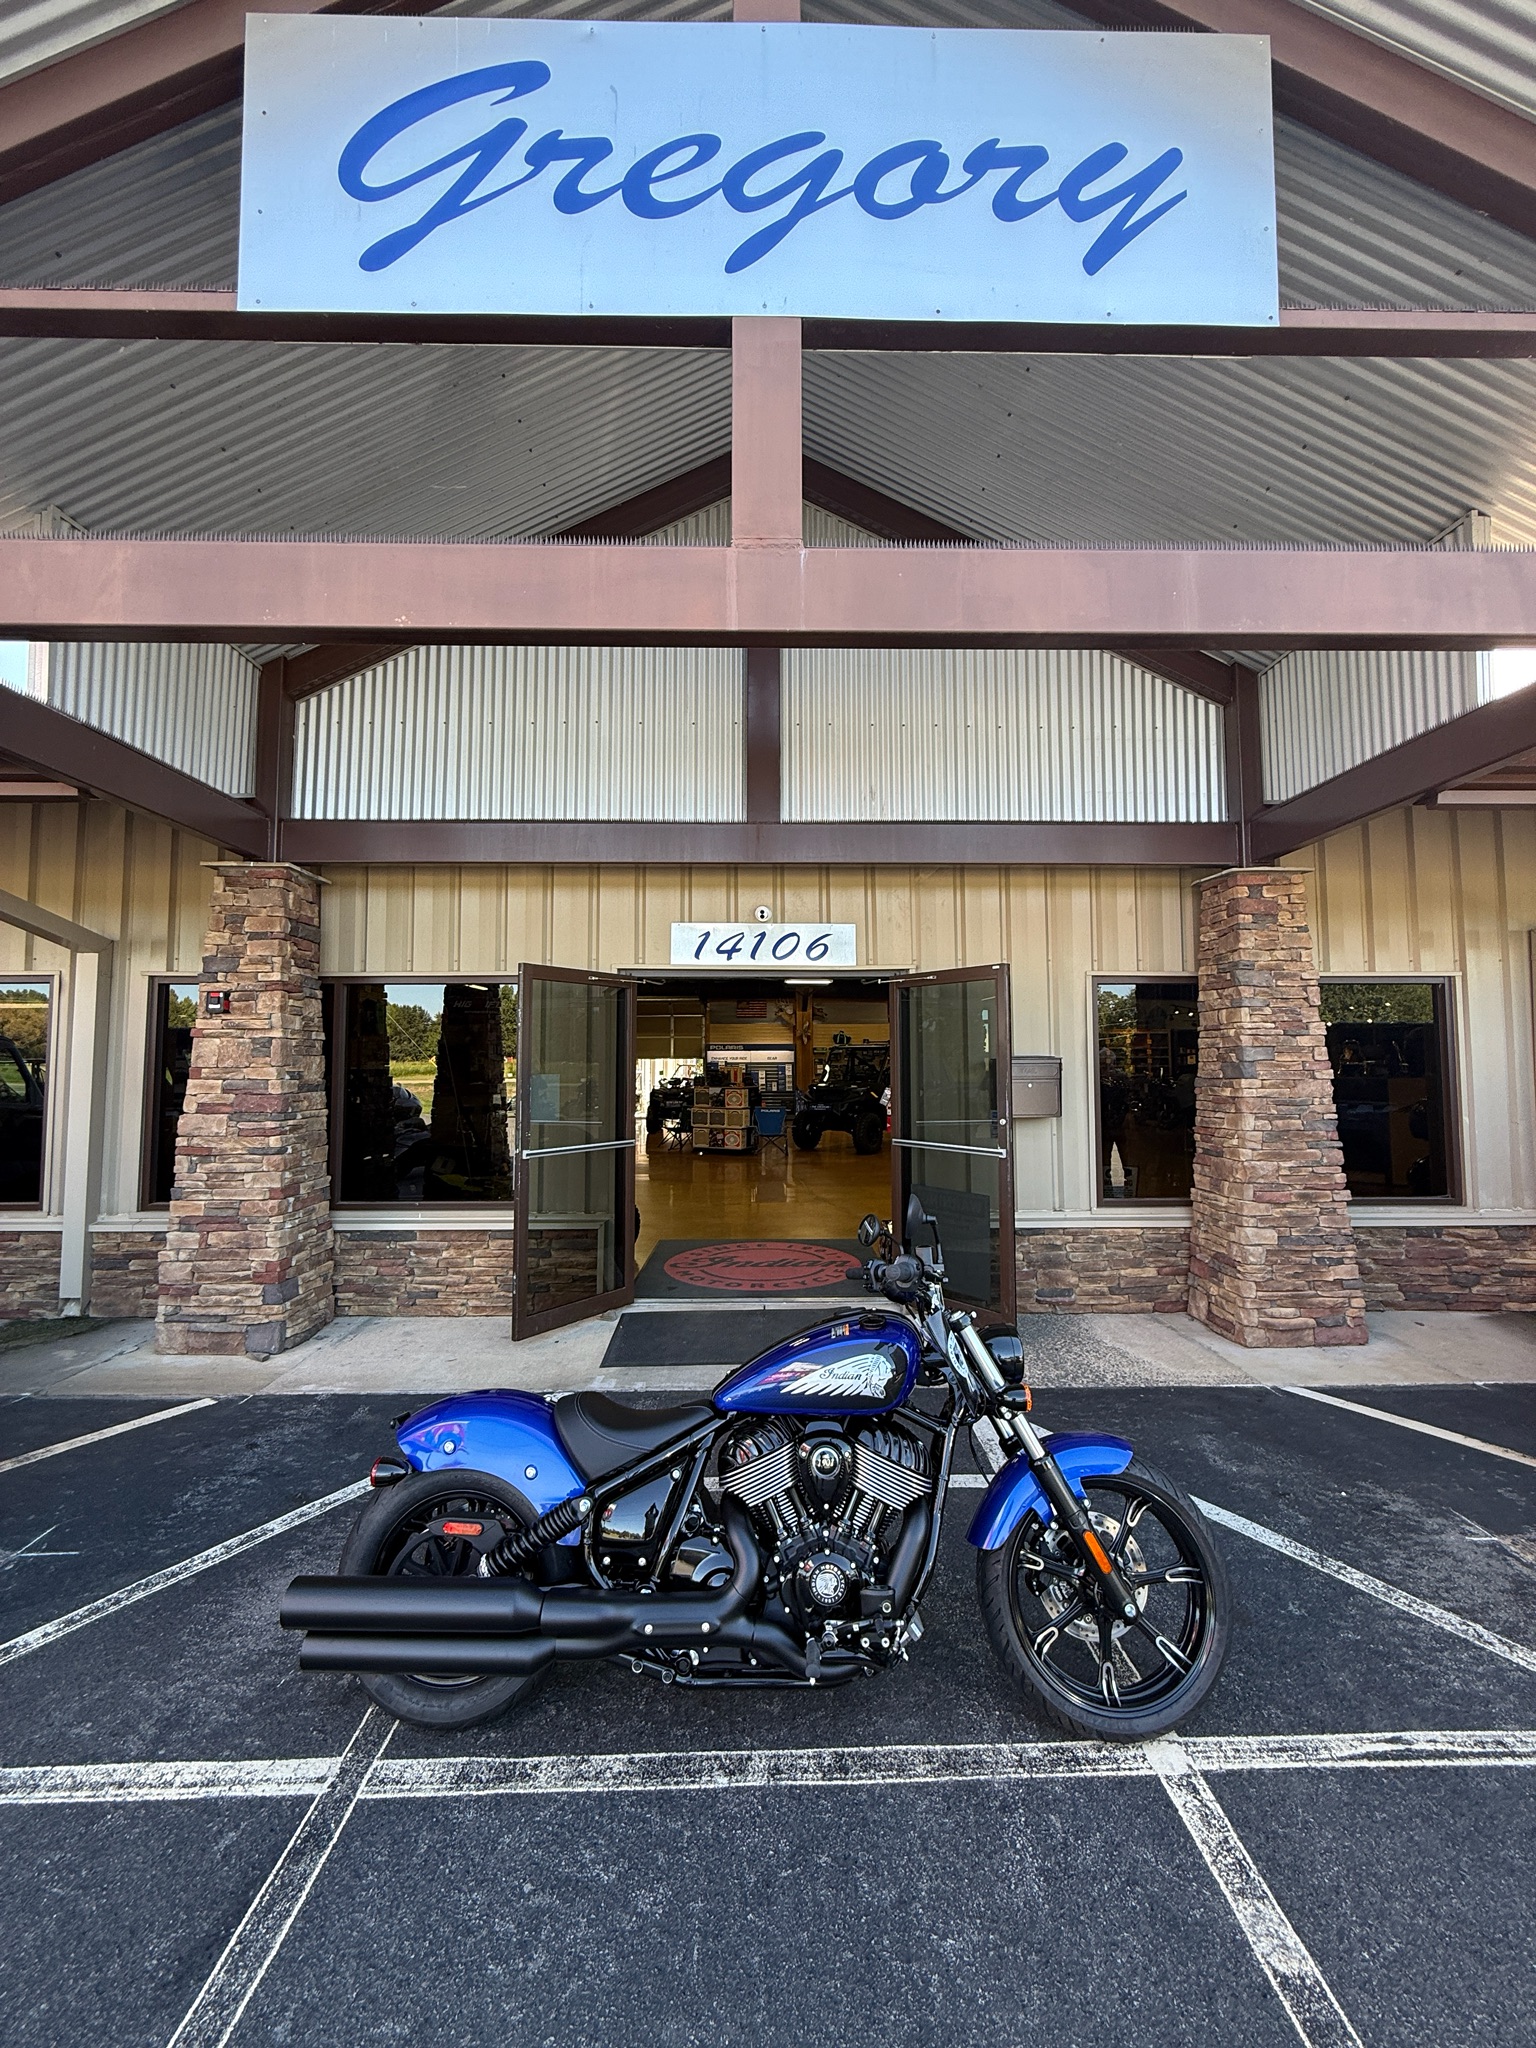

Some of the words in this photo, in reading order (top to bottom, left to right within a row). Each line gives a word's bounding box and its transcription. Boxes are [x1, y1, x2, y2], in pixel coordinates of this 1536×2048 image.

[338, 60, 1188, 277] Gregory
[694, 931, 833, 961] 14106
[669, 1255, 851, 1269] Indian
[819, 1367, 862, 1380] Indian
